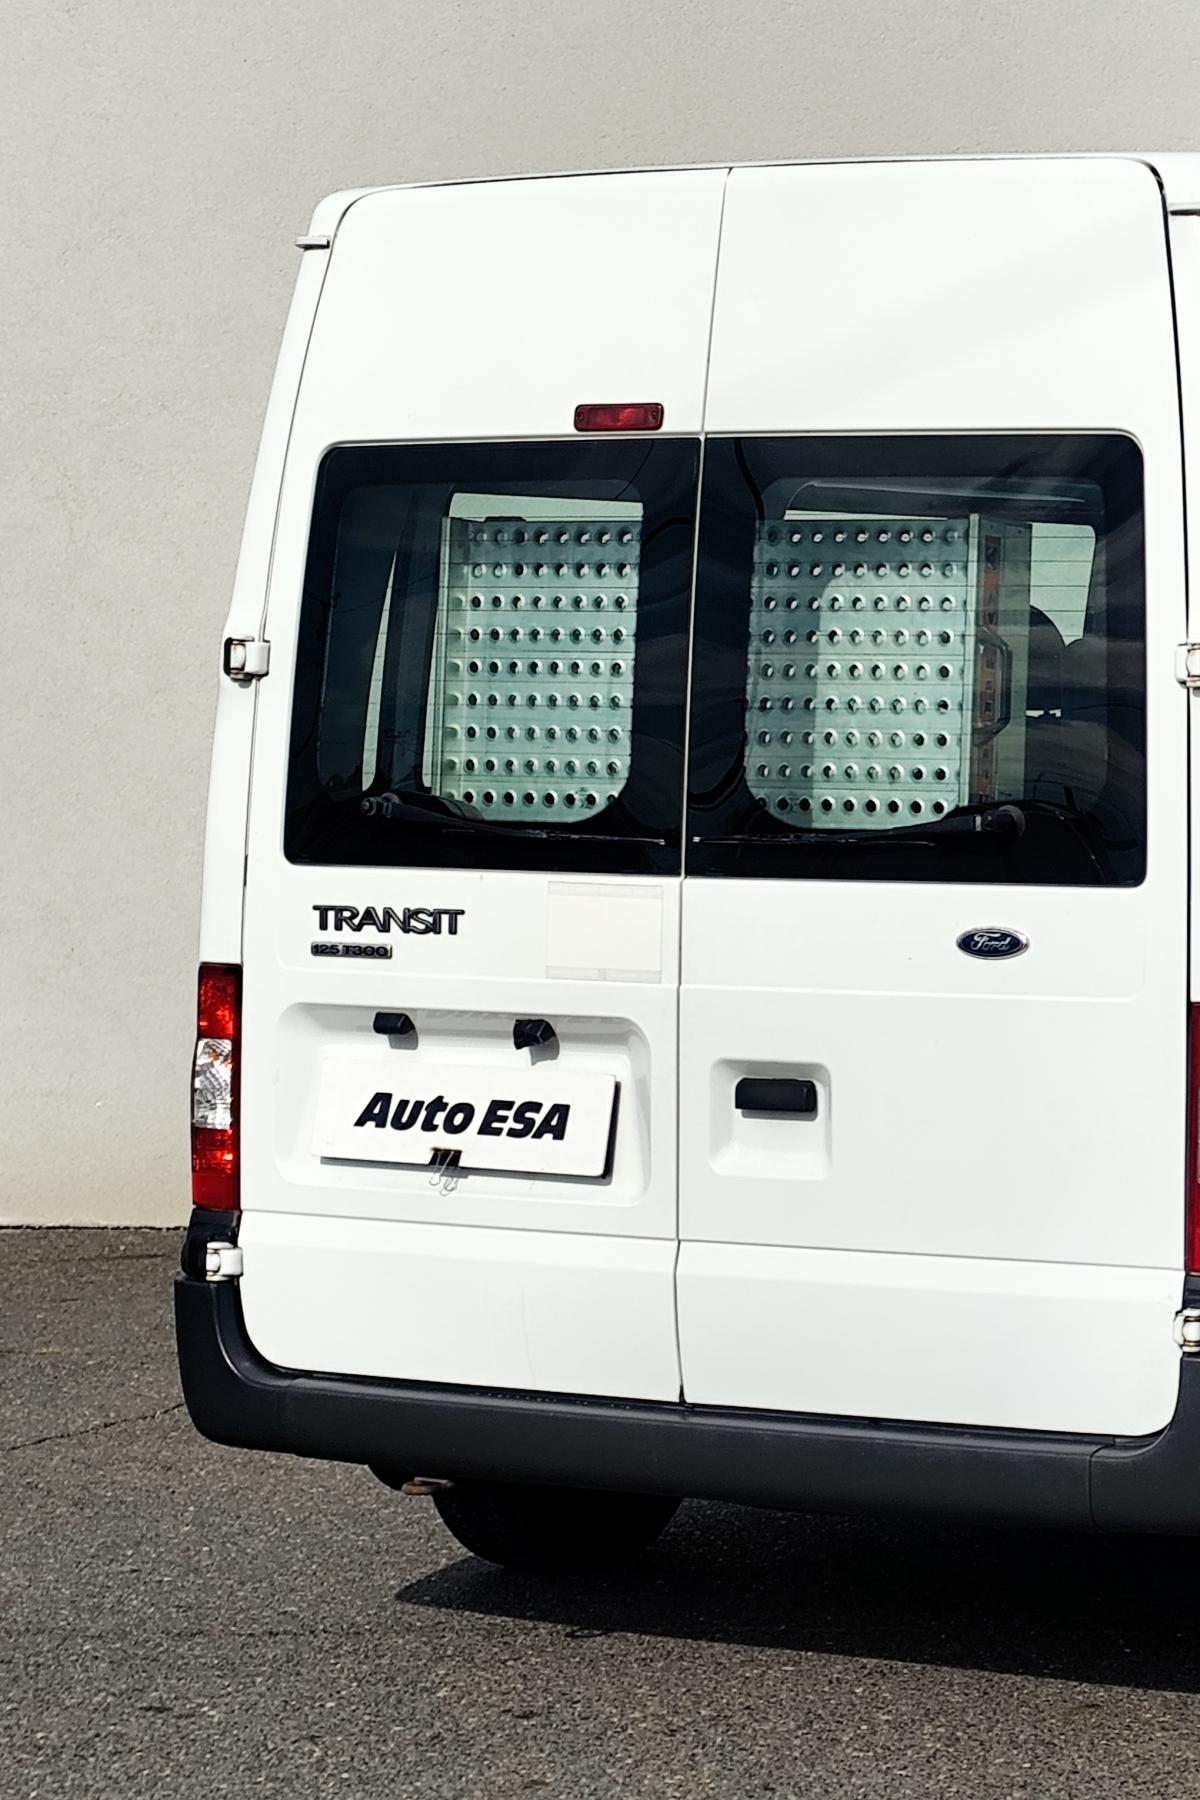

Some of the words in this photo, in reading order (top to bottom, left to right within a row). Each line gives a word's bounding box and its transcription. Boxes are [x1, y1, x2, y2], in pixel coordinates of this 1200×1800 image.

[312, 905, 465, 935] TRANSIT
[313, 943, 340, 955] 125
[971, 932, 1012, 951] Ford
[353, 1091, 476, 1135] Auto
[477, 1099, 571, 1141] ESA
